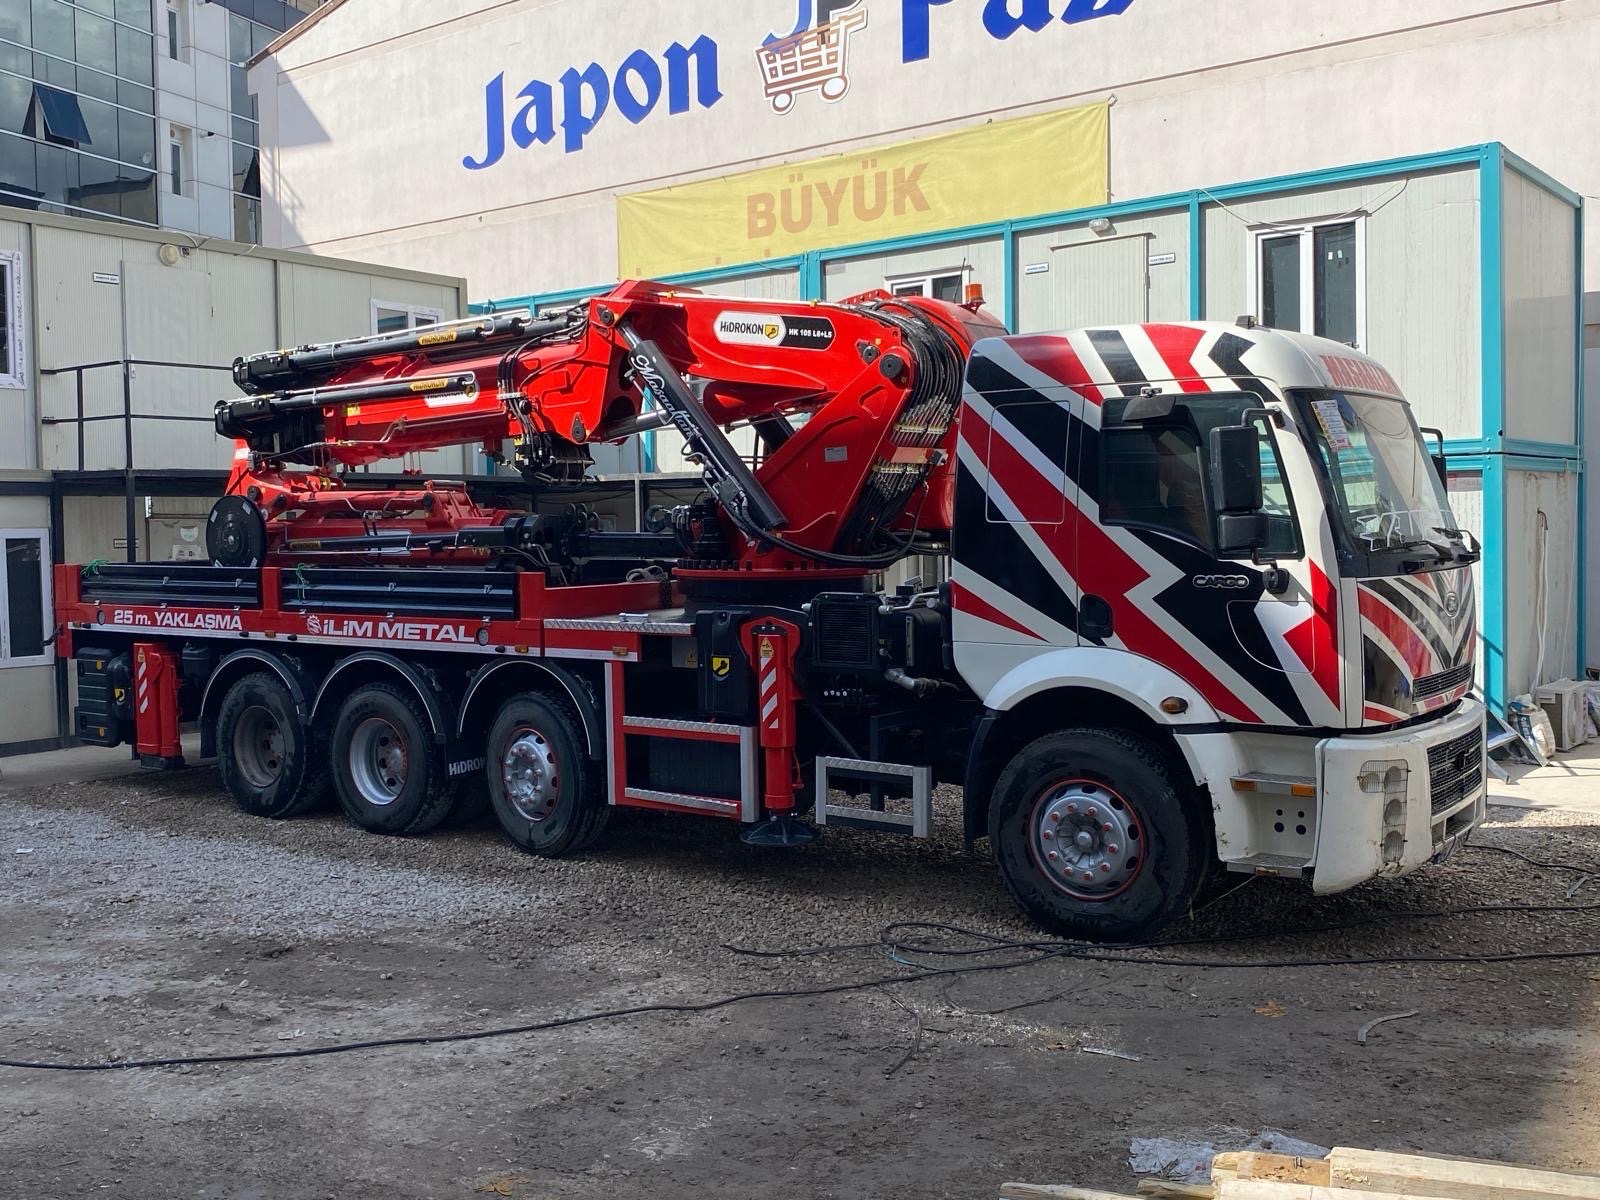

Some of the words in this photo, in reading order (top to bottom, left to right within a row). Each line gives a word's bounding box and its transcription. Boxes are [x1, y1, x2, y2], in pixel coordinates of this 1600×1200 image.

[462, 34, 724, 170] Japon
[747, 159, 930, 240] BÜYÜK
[788, 328, 799, 336] HK
[800, 328, 812, 337] 105
[1193, 575, 1249, 588] CARGO
[114, 609, 133, 624] 25
[136, 615, 151, 625] m.
[378, 622, 475, 643] METAL
